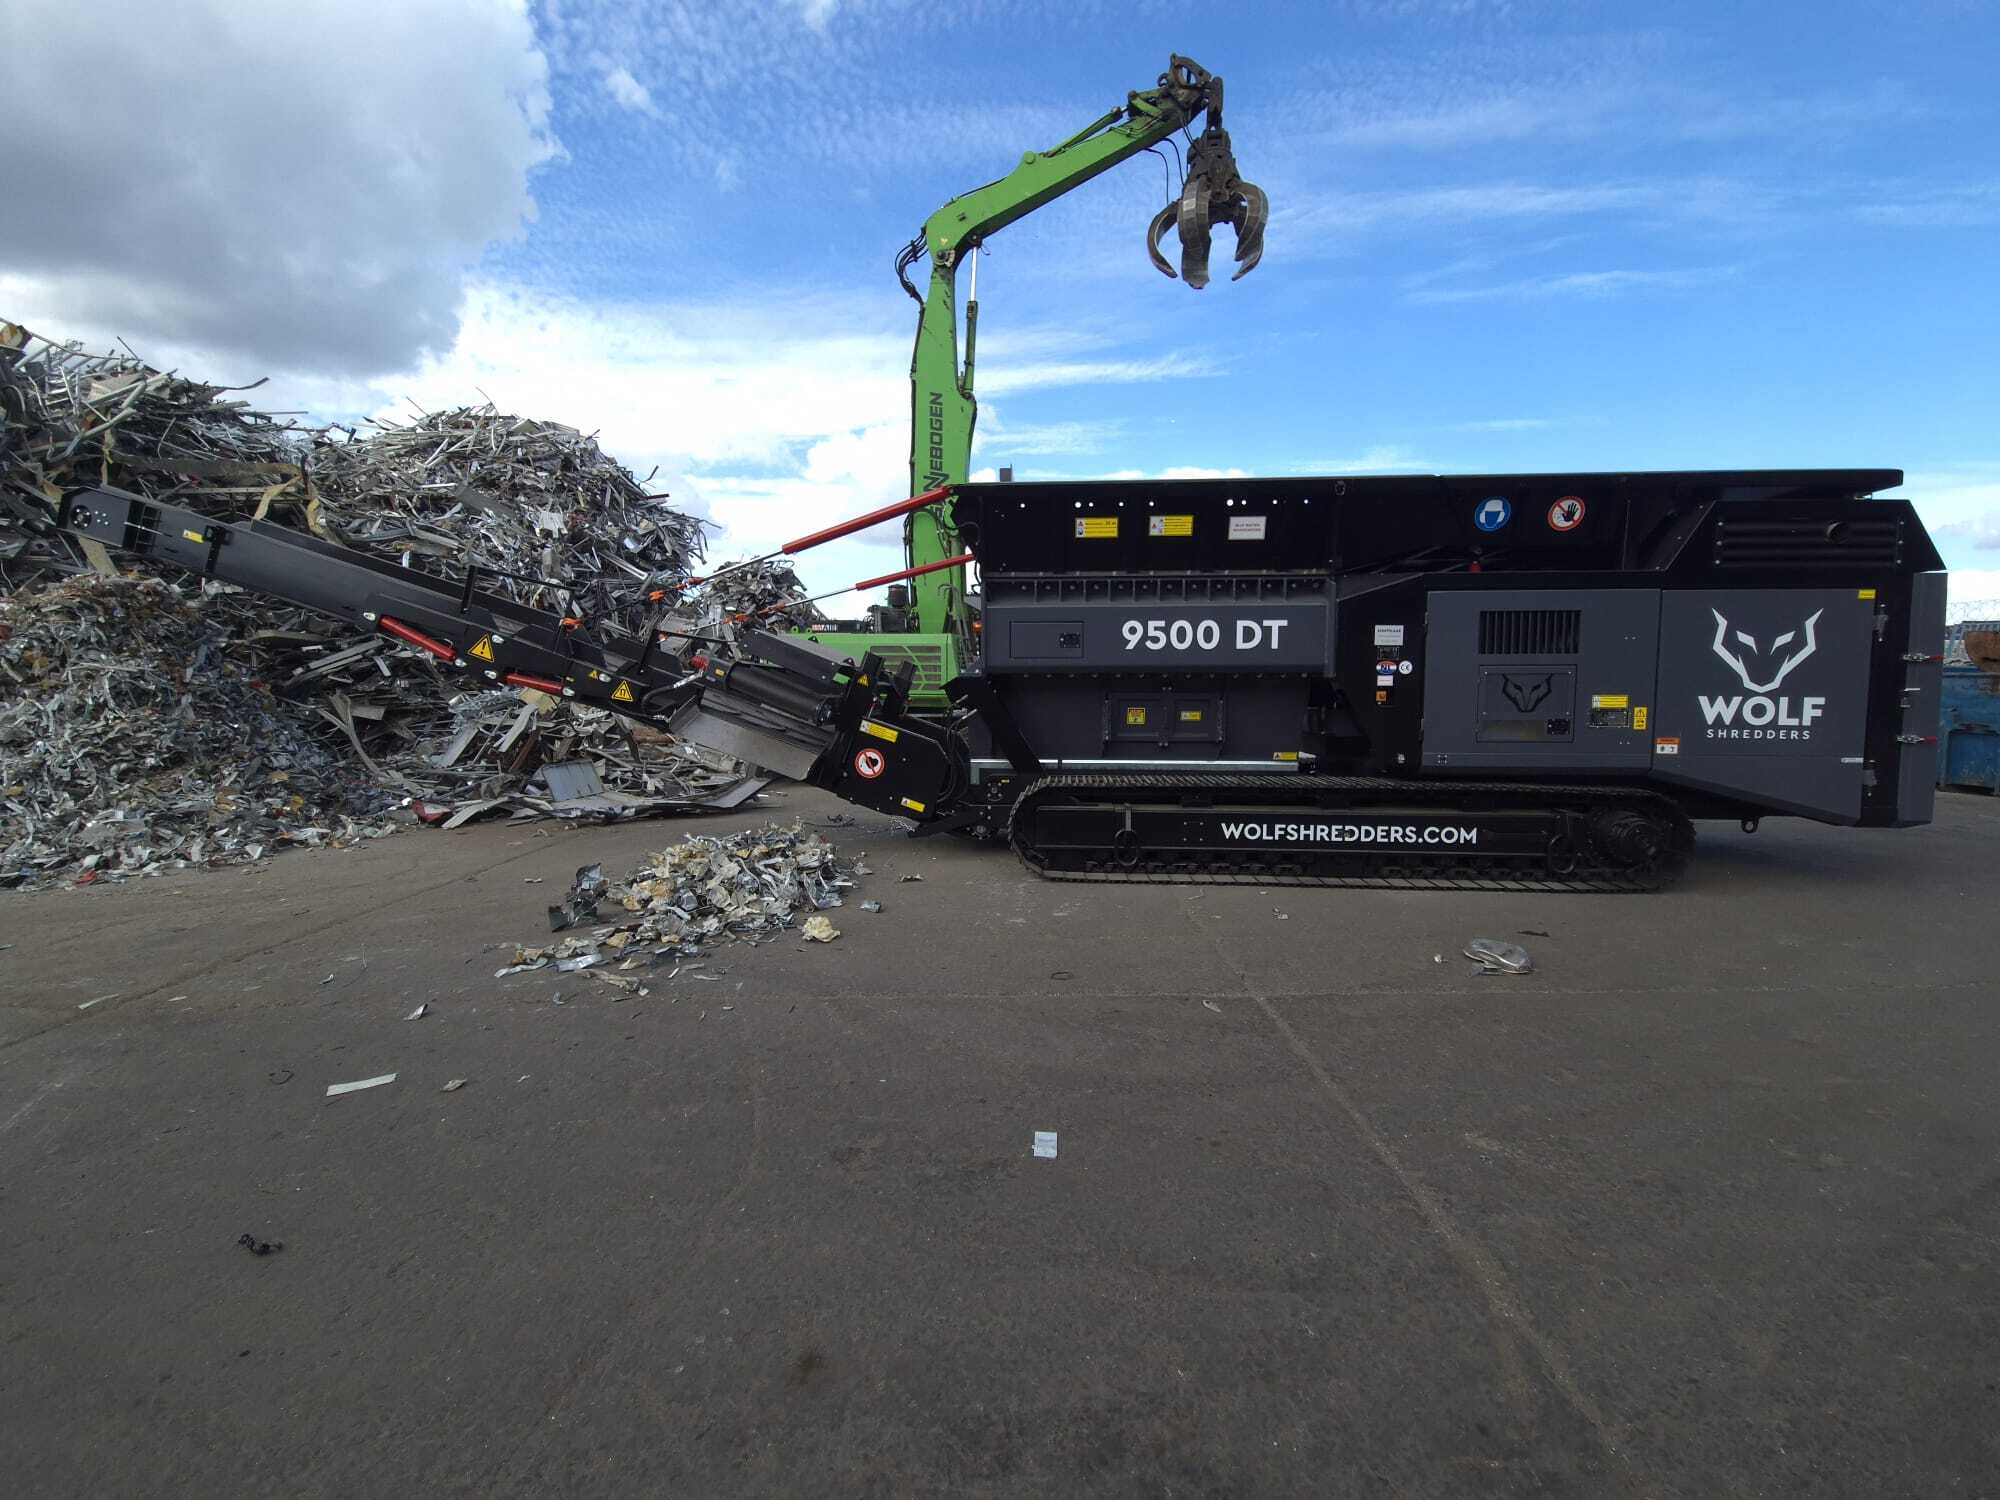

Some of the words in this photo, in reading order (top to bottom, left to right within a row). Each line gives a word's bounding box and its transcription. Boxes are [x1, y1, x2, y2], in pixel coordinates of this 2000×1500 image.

[1121, 619, 1220, 650] 9500
[1236, 619, 1288, 649] DT
[1698, 695, 1826, 726] WOLF
[1707, 728, 1811, 740] SHREDDERS
[1221, 823, 1478, 844] WOLFSHREDDERS.COM
